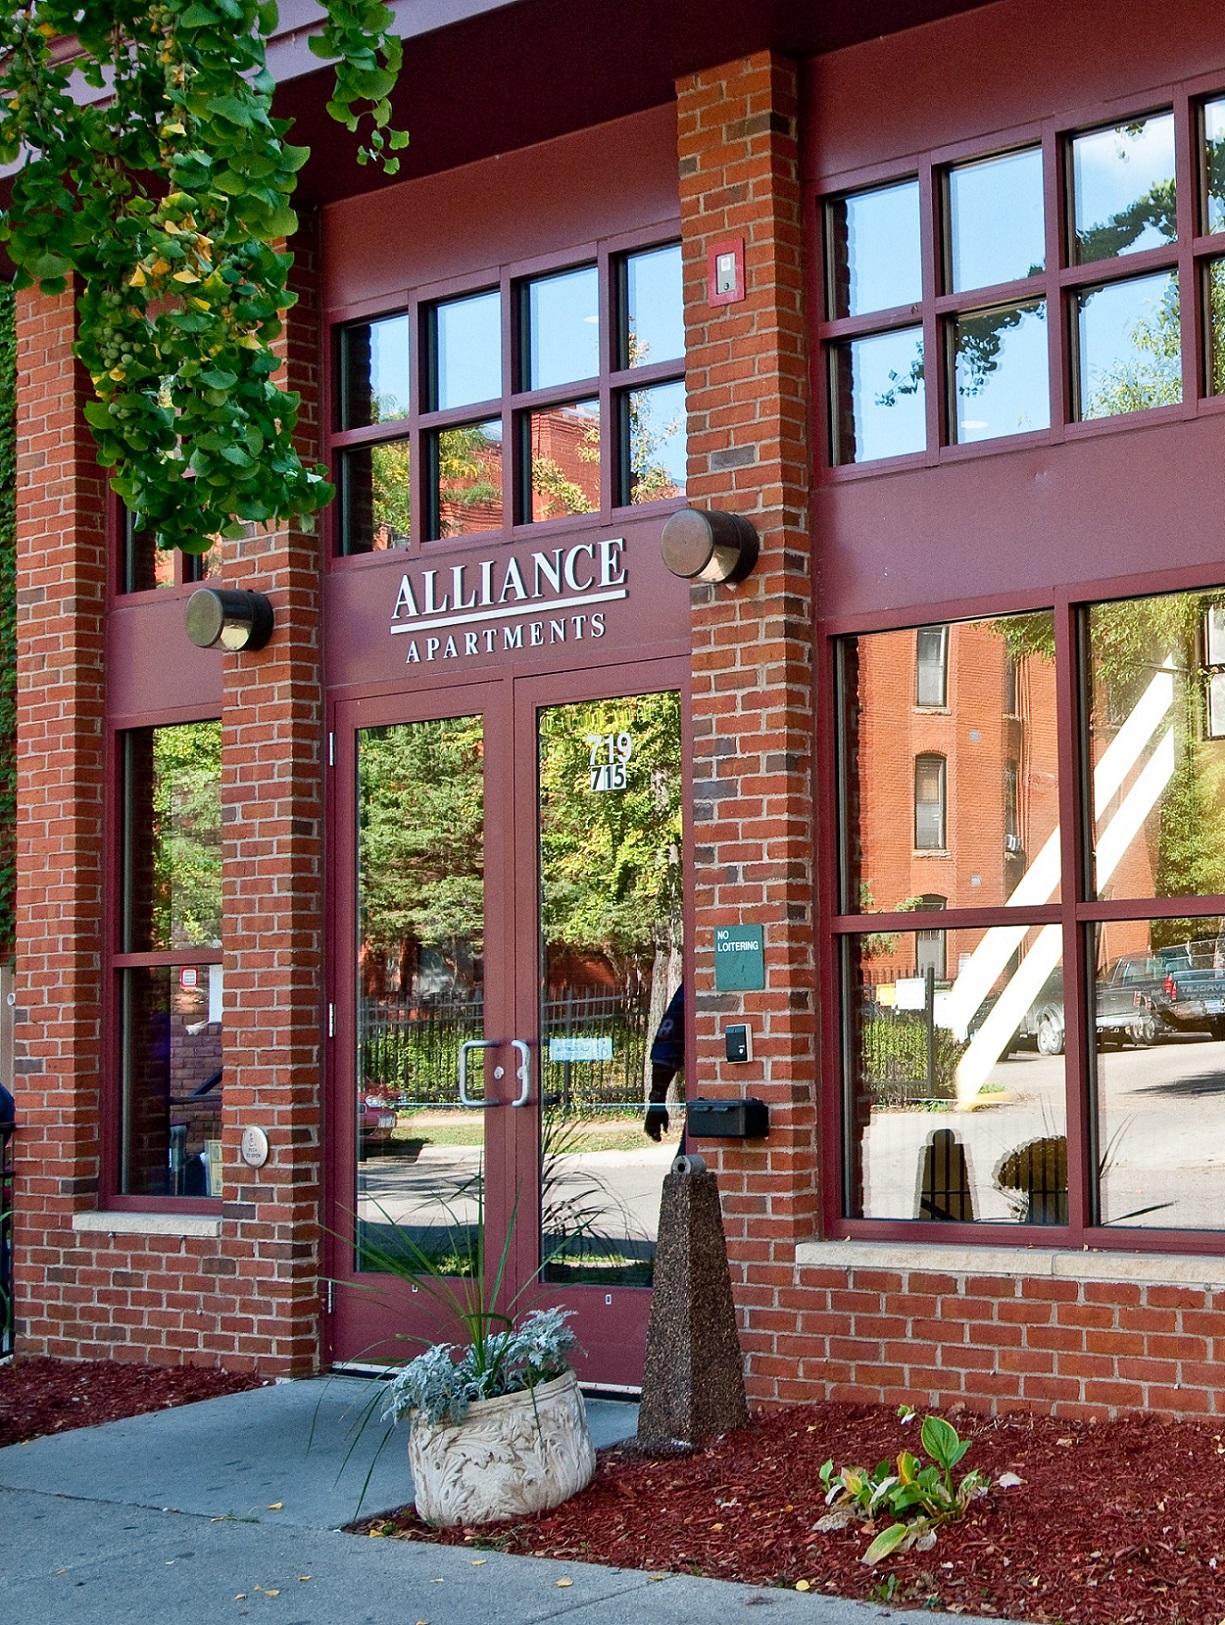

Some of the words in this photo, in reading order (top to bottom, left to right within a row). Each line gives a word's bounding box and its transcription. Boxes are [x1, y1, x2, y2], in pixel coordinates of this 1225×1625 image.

[391, 538, 626, 619] ALLIANCE
[406, 613, 606, 662] APARTMENTS
[586, 732, 632, 764] 719
[591, 765, 625, 789] 715
[717, 930, 729, 940] NO
[717, 941, 759, 952] LOITERING
